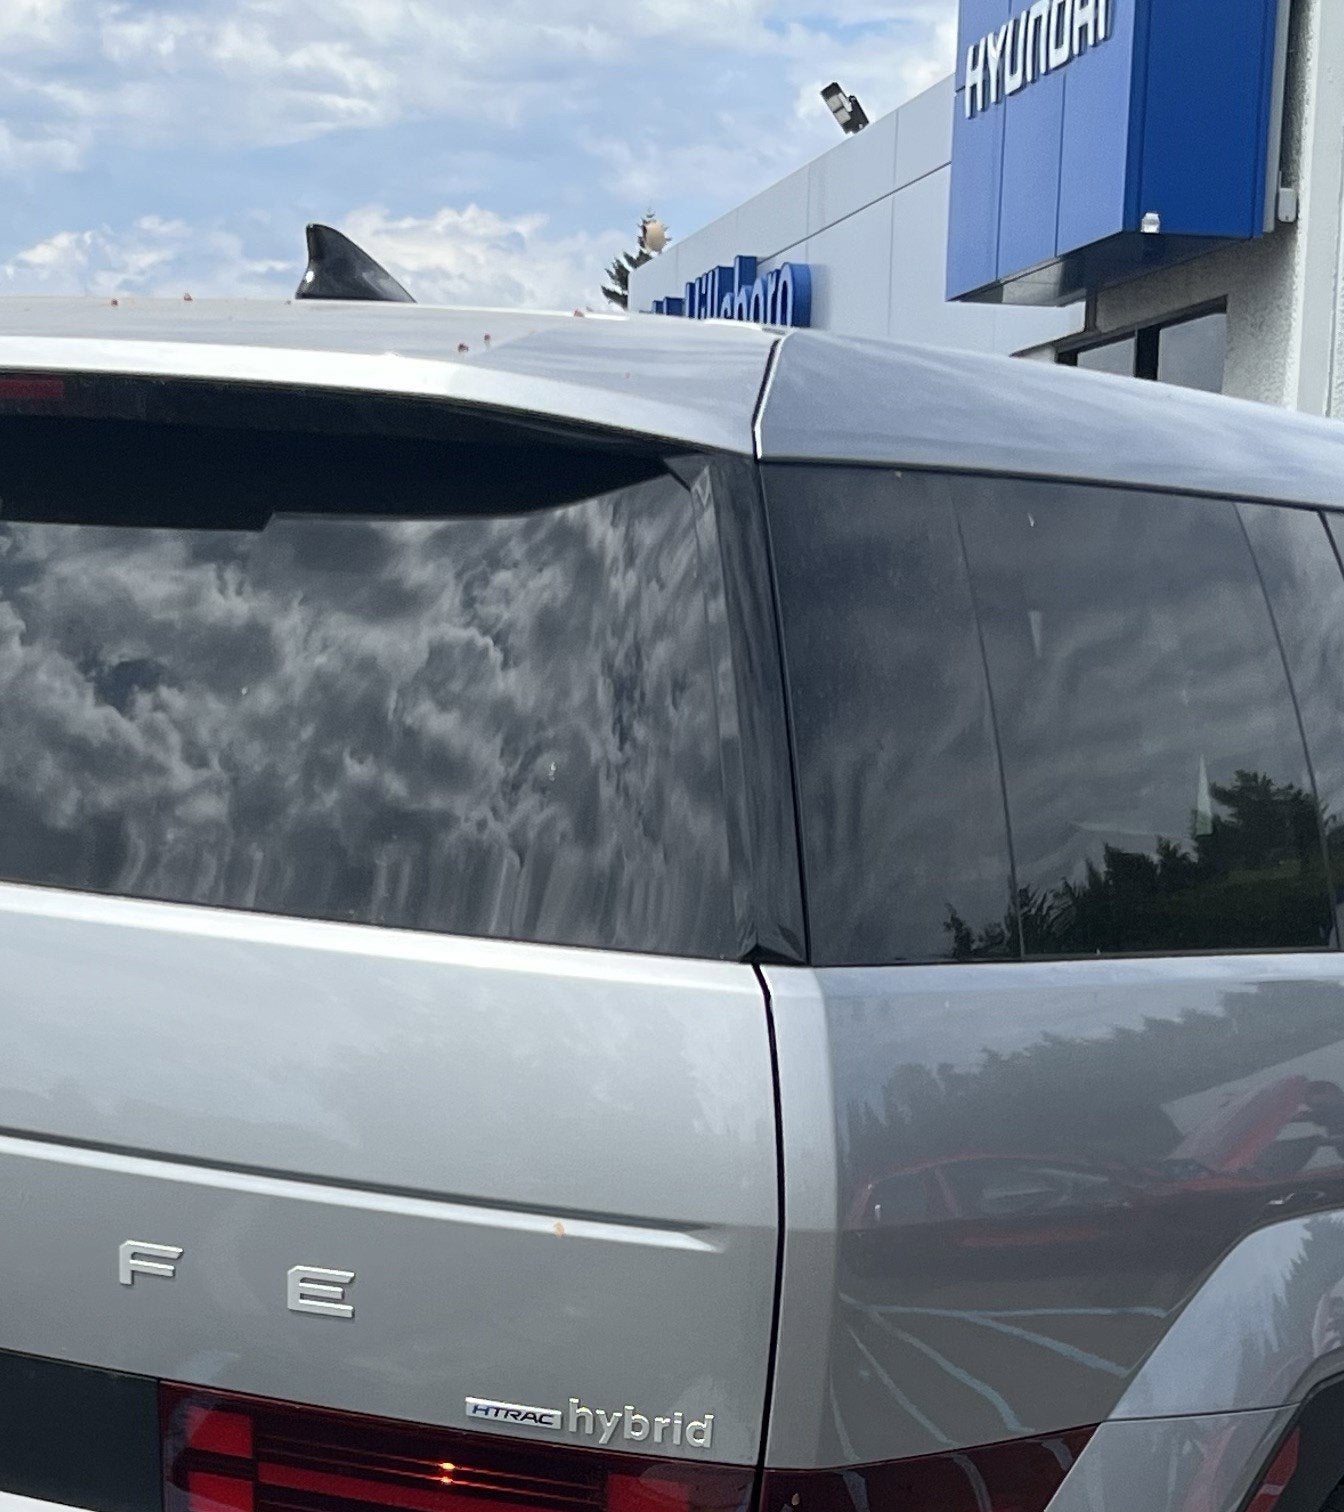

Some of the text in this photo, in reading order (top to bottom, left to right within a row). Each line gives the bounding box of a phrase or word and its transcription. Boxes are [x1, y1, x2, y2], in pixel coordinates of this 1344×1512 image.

[118, 1239, 356, 1319] FE
[471, 1397, 715, 1449] HTRAC hybrid
